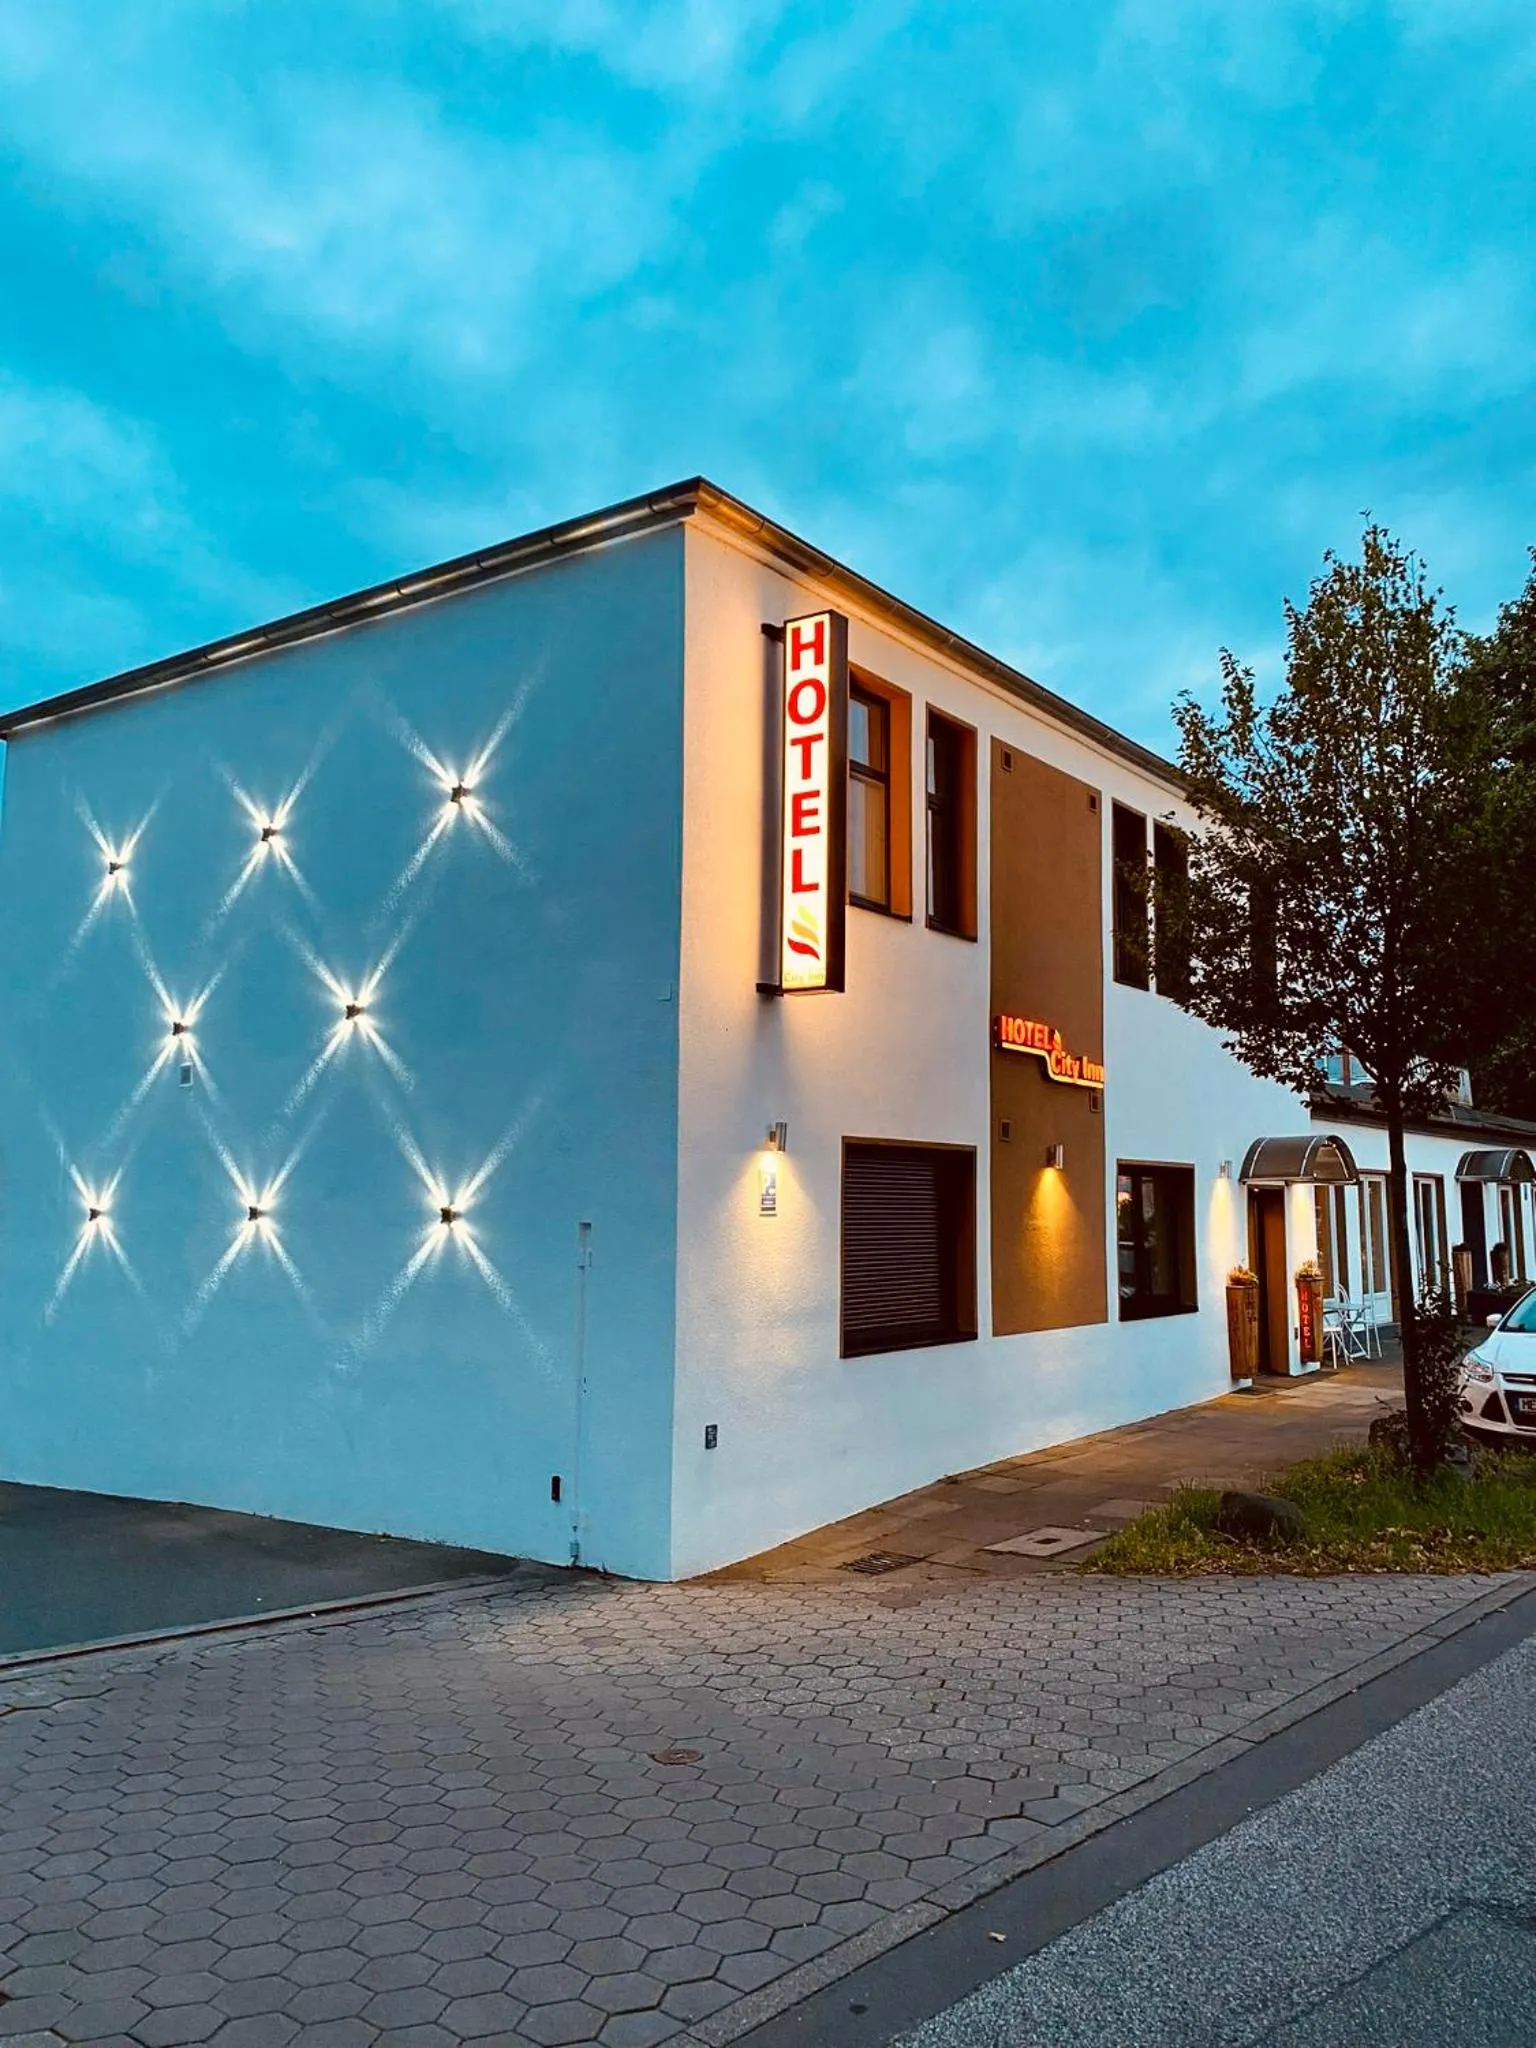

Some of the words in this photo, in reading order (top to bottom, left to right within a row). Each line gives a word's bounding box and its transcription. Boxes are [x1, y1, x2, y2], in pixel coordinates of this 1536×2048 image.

[787, 620, 827, 894] HOTEL
[1001, 1015, 1053, 1050] HOTEL
[1051, 1049, 1081, 1079] City
[1082, 1055, 1104, 1082] Inn
[1301, 1289, 1312, 1349] HOTEL
